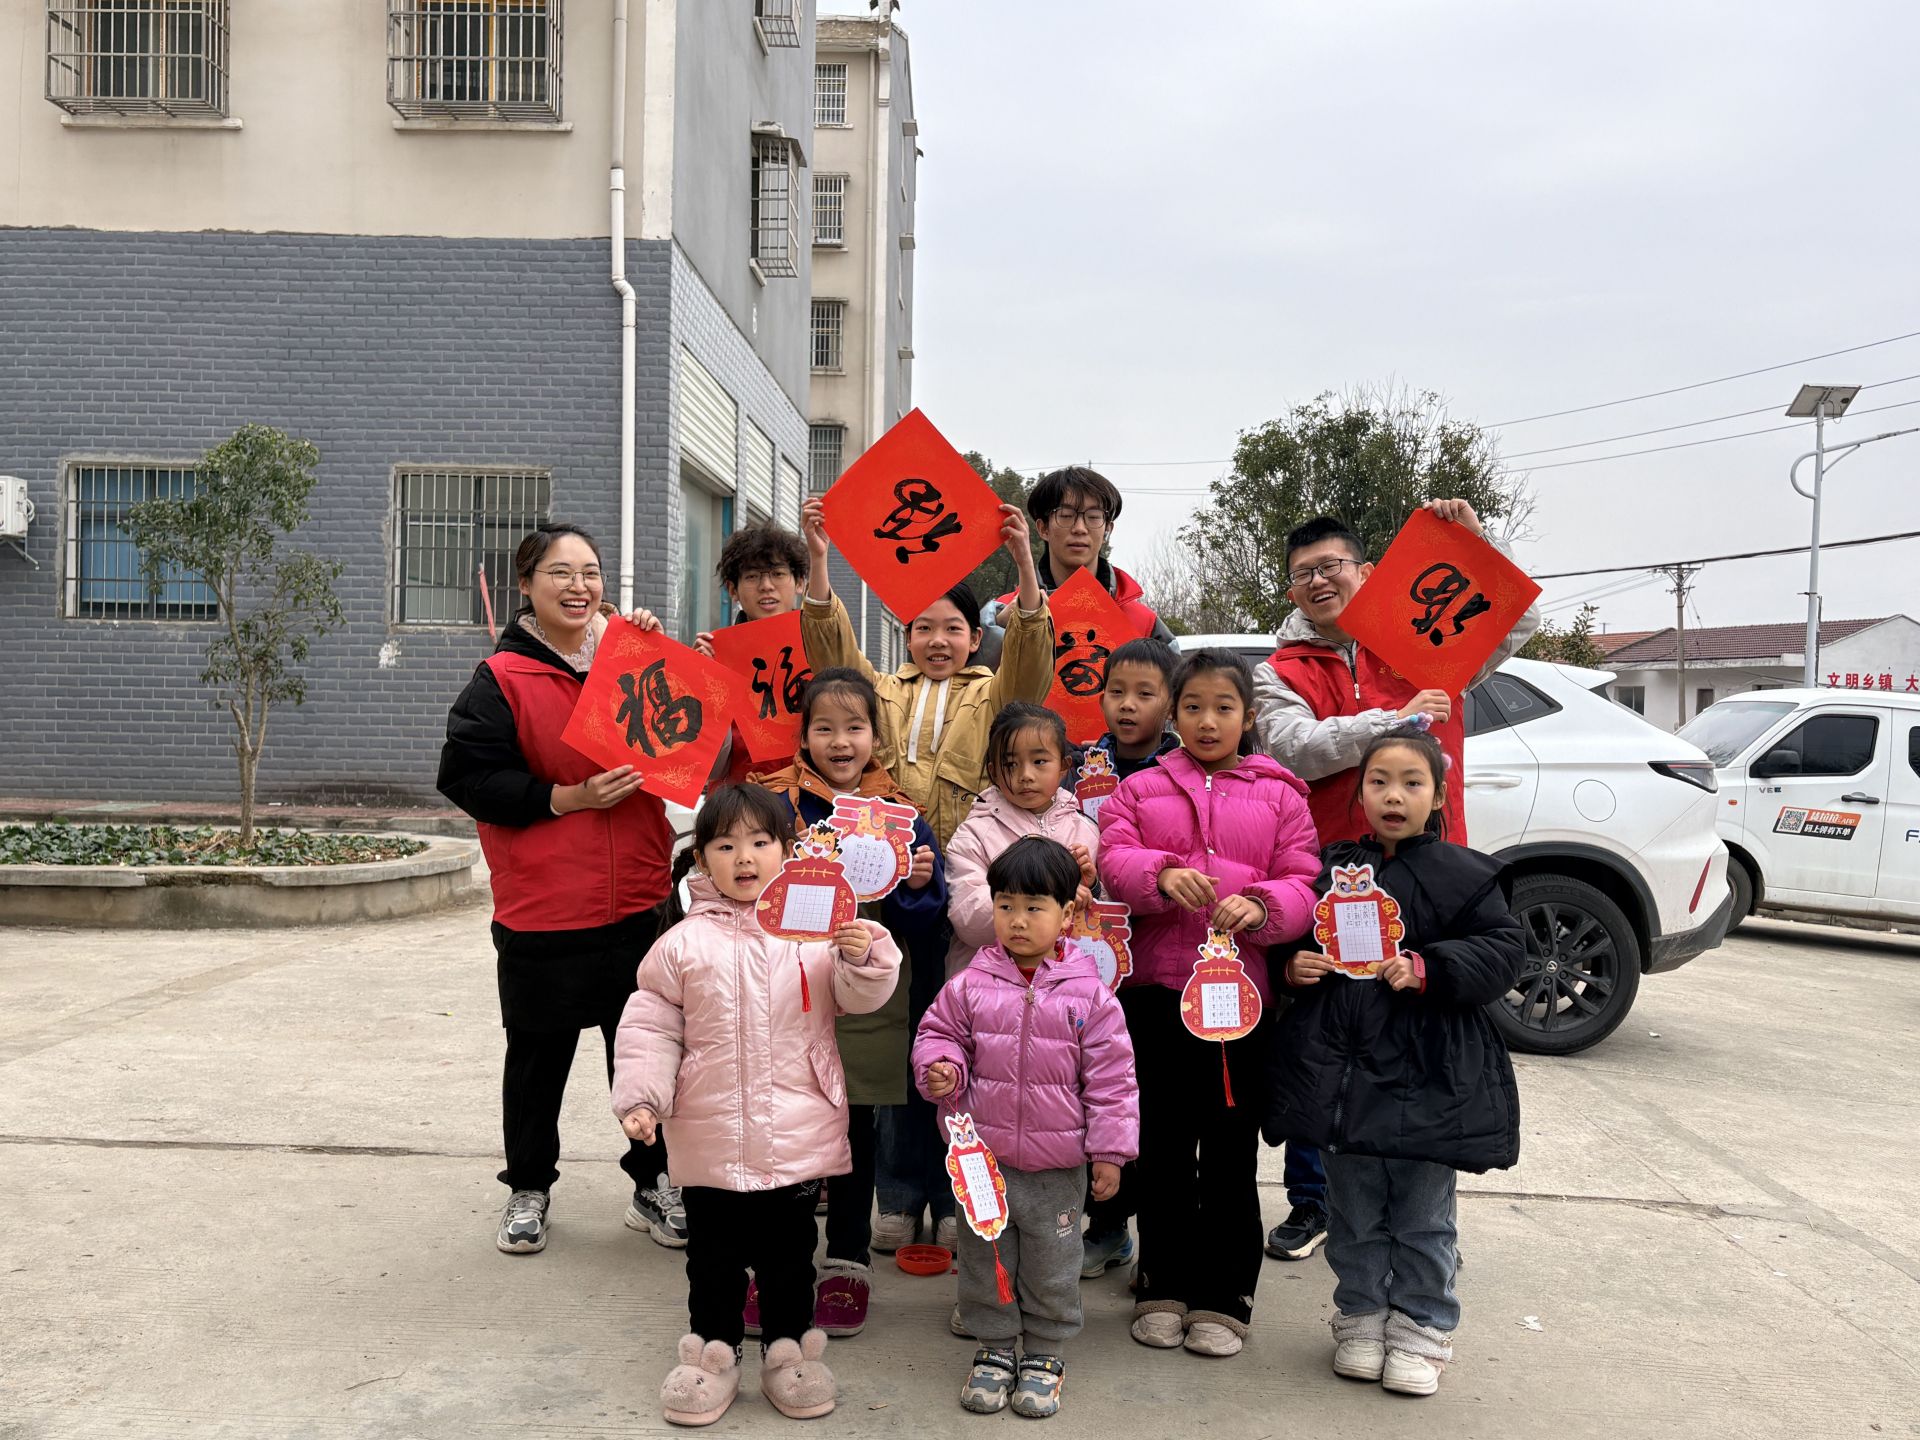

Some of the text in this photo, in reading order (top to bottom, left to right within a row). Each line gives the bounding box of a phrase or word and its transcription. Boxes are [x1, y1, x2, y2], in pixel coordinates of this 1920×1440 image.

[1826, 671, 1893, 691] 文明乡镇
[615, 657, 703, 758] 福
[769, 886, 784, 926] 快乐成长
[1381, 898, 1402, 939] 安康
